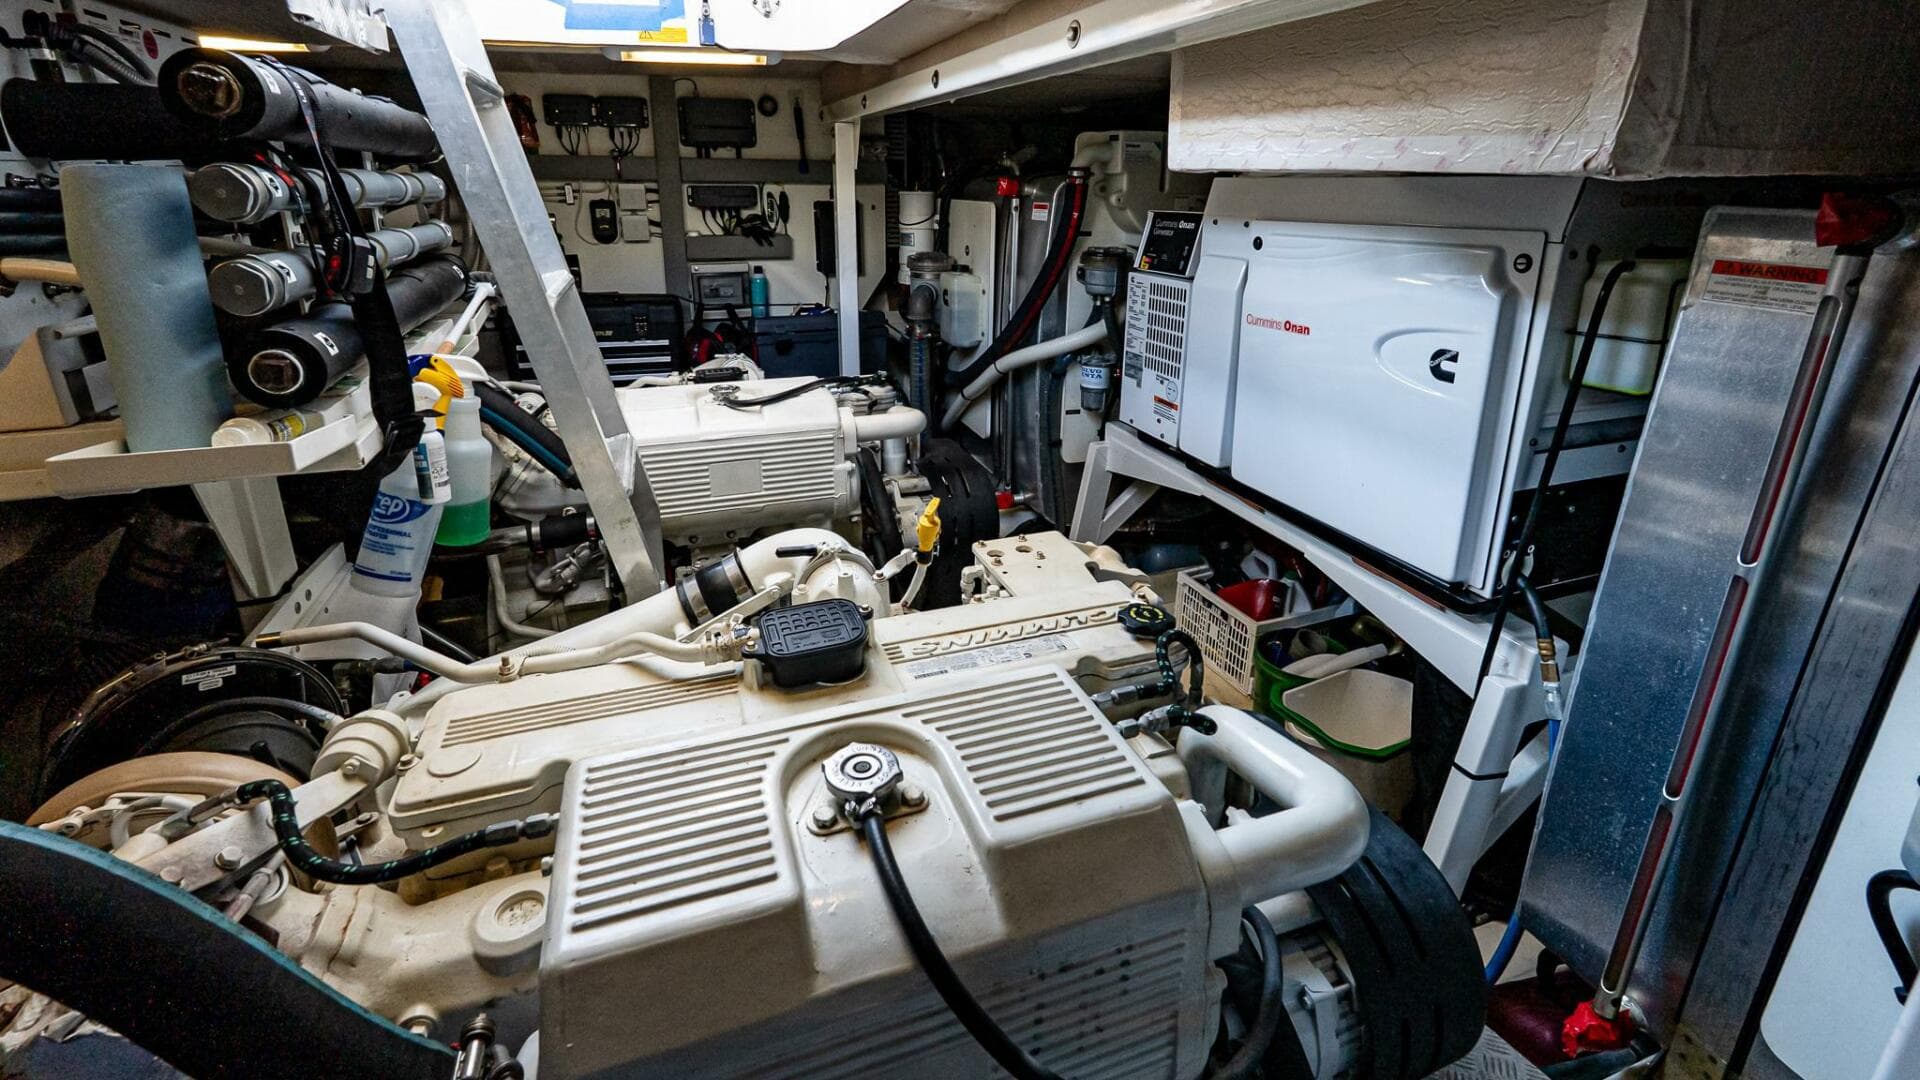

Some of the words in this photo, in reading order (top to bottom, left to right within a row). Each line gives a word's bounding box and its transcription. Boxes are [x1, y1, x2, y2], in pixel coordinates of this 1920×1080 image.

[1740, 262, 1817, 281] WARNING
[1246, 313, 1282, 331] Cummins
[1283, 320, 1311, 336] Onan
[912, 609, 1117, 654] CUMMINS
